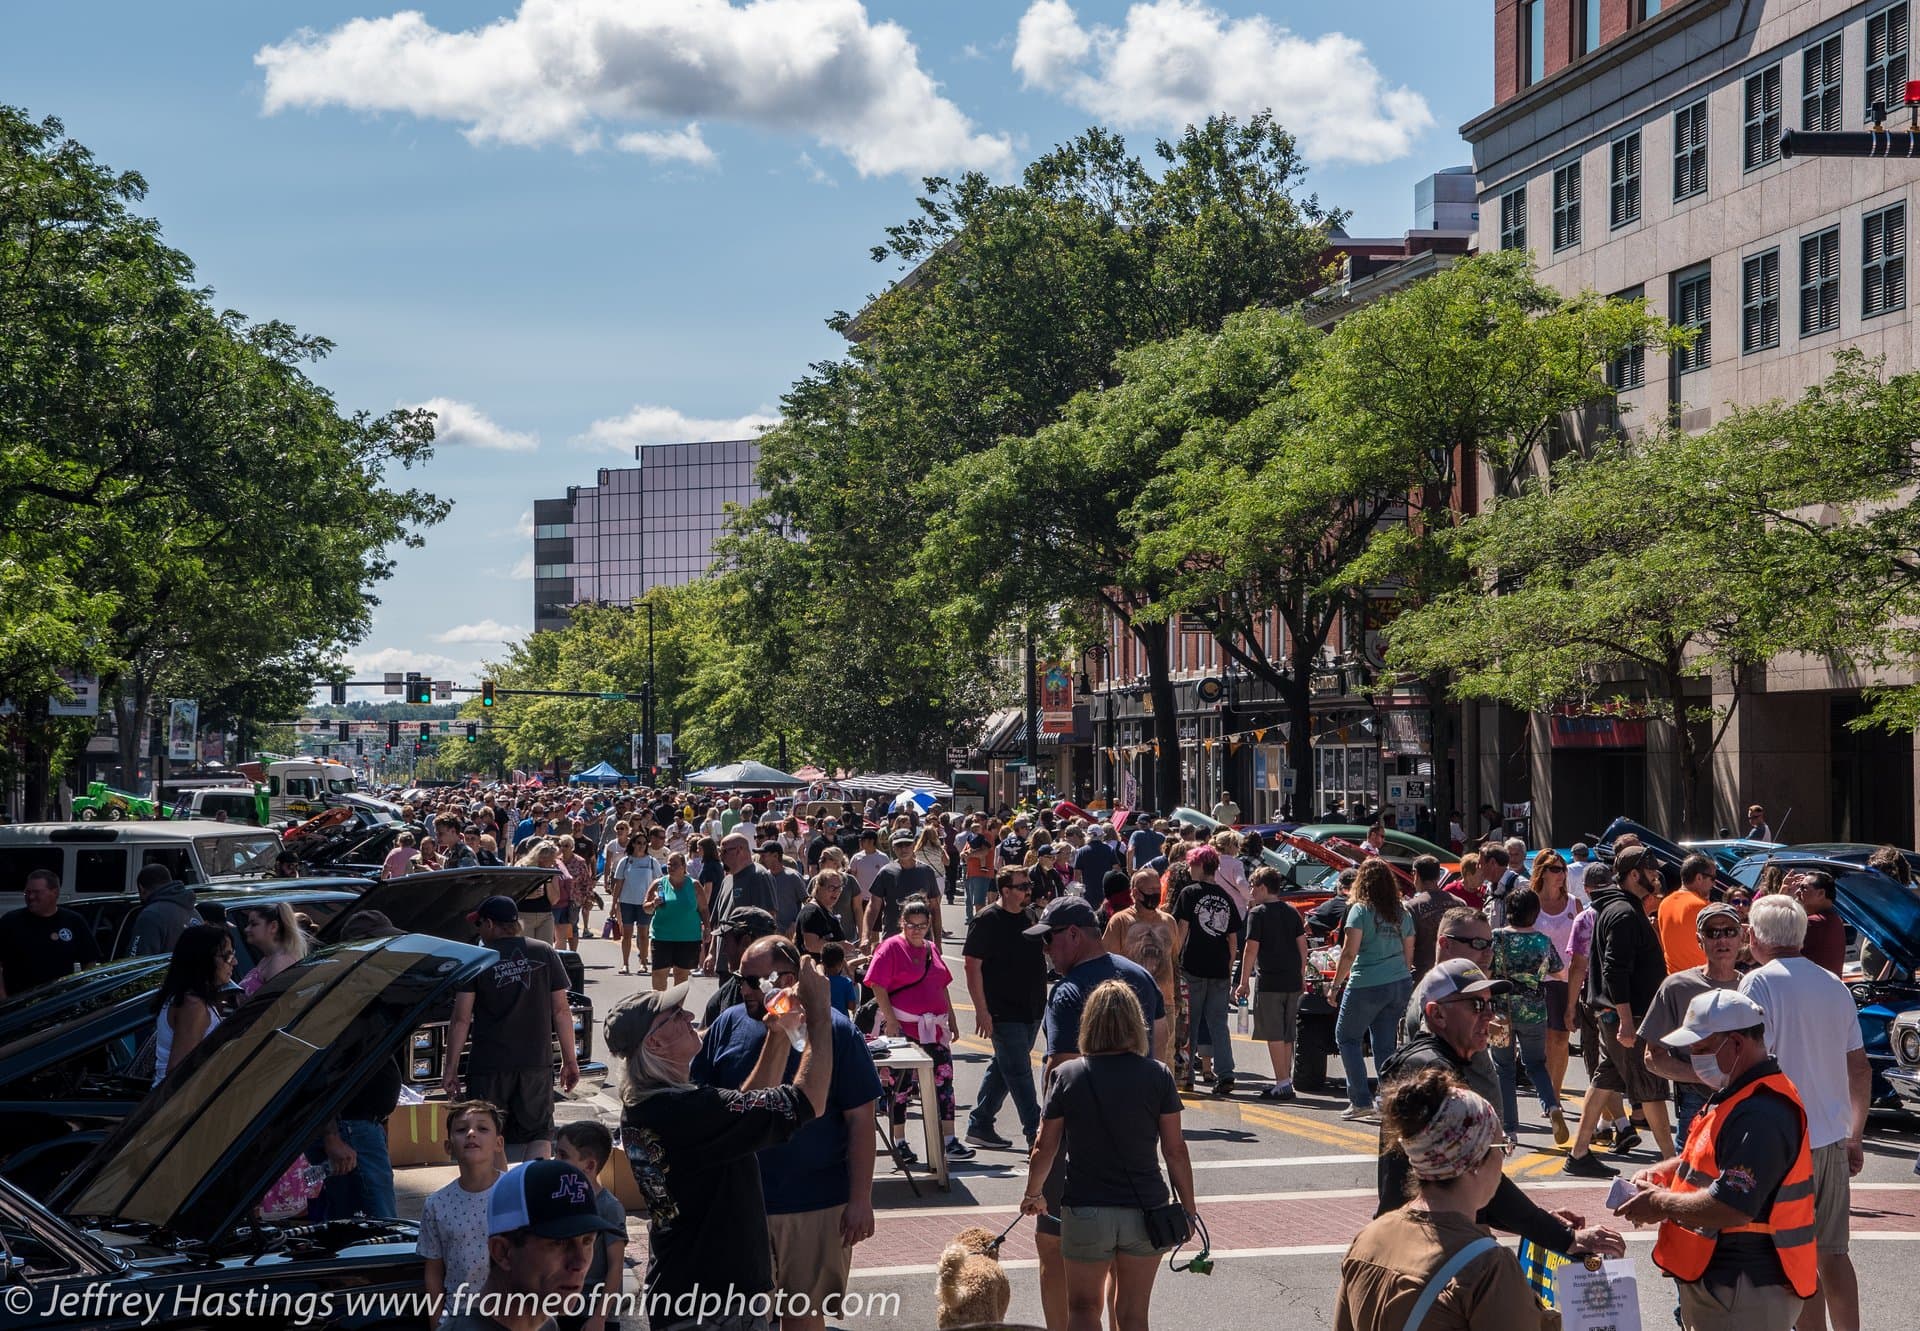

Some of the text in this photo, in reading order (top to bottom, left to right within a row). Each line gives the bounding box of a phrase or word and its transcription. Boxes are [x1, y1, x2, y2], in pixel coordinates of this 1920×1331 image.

[493, 958, 529, 972] TOUR OF
[494, 965, 532, 980] AMERICA
